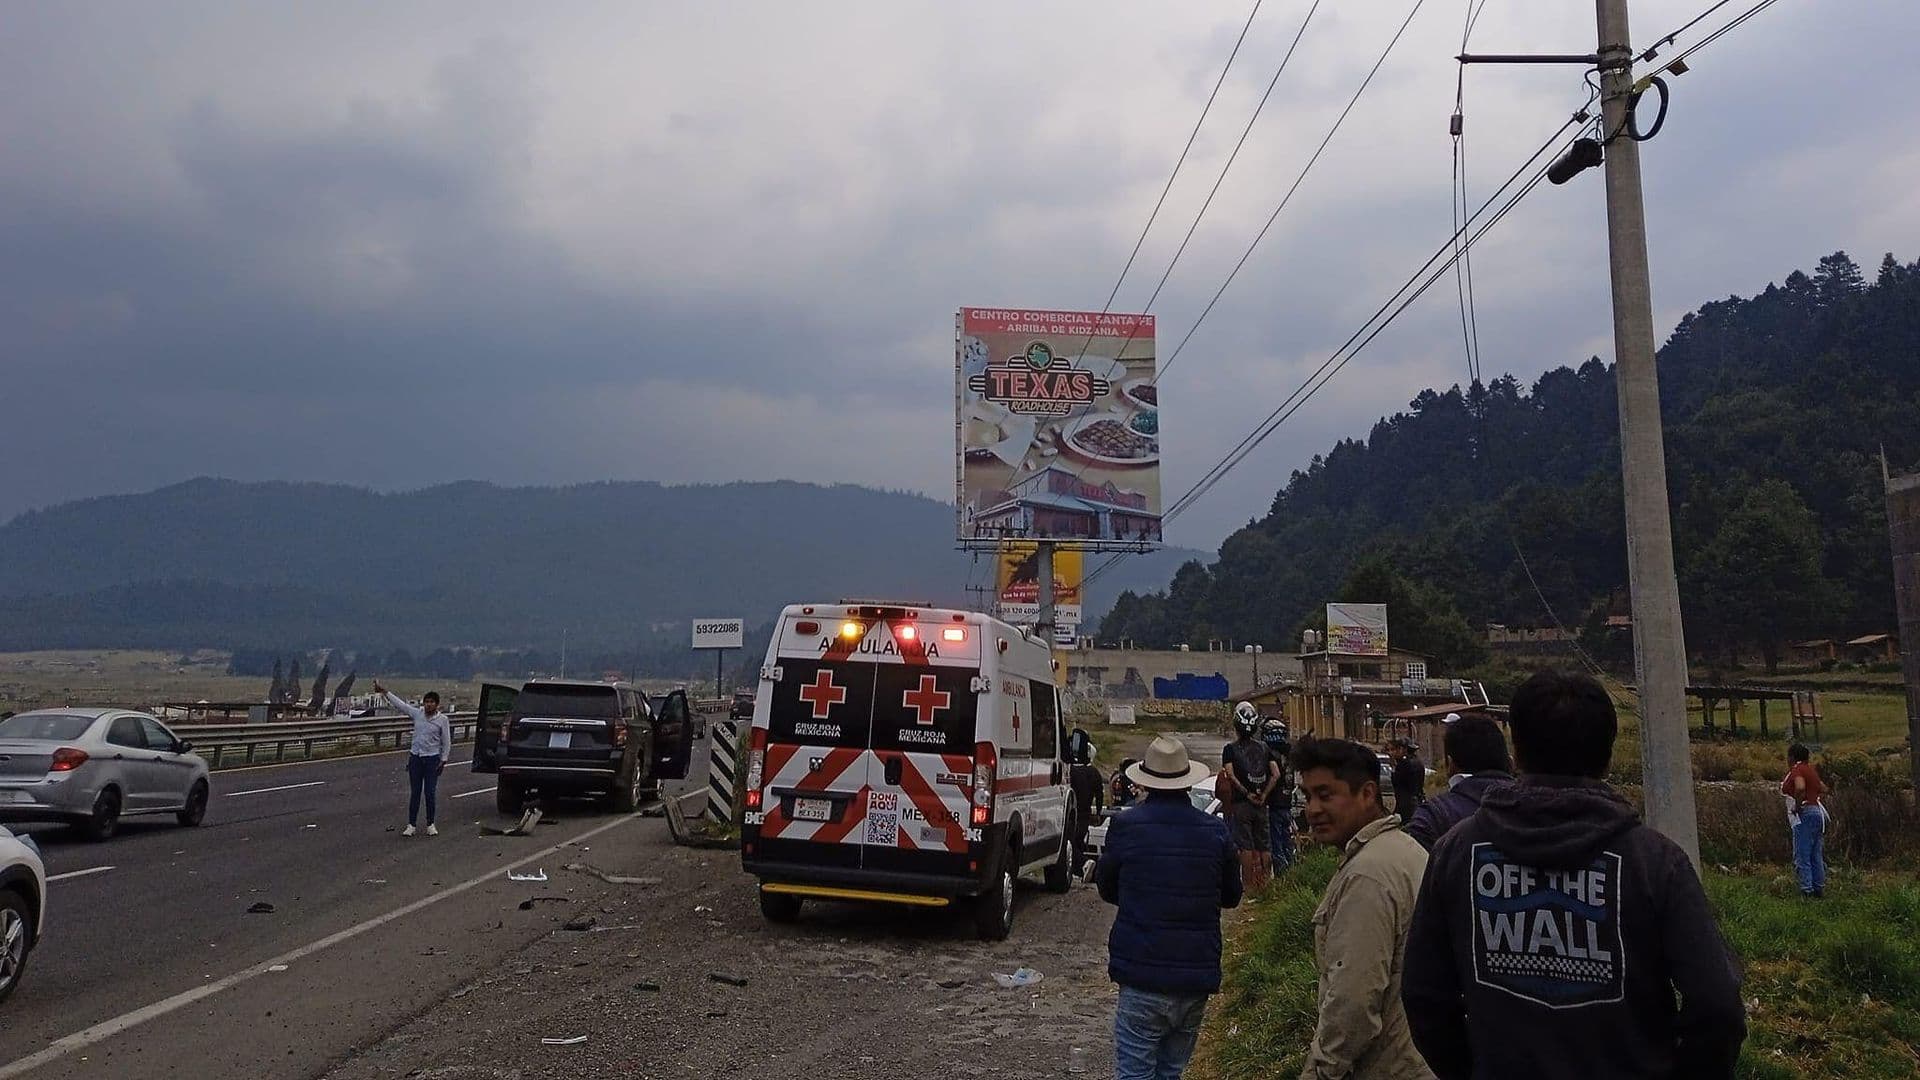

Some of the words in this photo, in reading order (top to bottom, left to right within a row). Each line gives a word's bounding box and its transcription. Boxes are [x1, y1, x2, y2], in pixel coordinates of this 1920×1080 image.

[972, 310, 1020, 321] CENTRO
[1023, 312, 1092, 324] COMERCIAL
[1095, 315, 1135, 326] SANTA
[1006, 323, 1048, 333] ARRIBA
[1051, 325, 1066, 334] DE
[1068, 326, 1120, 336] KIDZANIA
[990, 371, 1091, 399] TEXAS
[1011, 401, 1071, 412] ROADHOUSE
[696, 623, 739, 634] 59322086
[818, 636, 939, 657] AULAIA
[796, 722, 817, 731] CRUZ
[819, 724, 841, 732] ROJA
[795, 729, 841, 737] MEXICANA
[899, 729, 922, 737] CRUZ
[923, 731, 946, 739] ROJA
[898, 735, 946, 744] MEXICANA
[870, 792, 898, 801] DONA
[1476, 862, 1537, 898] OFF
[1544, 869, 1606, 906] THE
[1479, 908, 1612, 961] WALL
